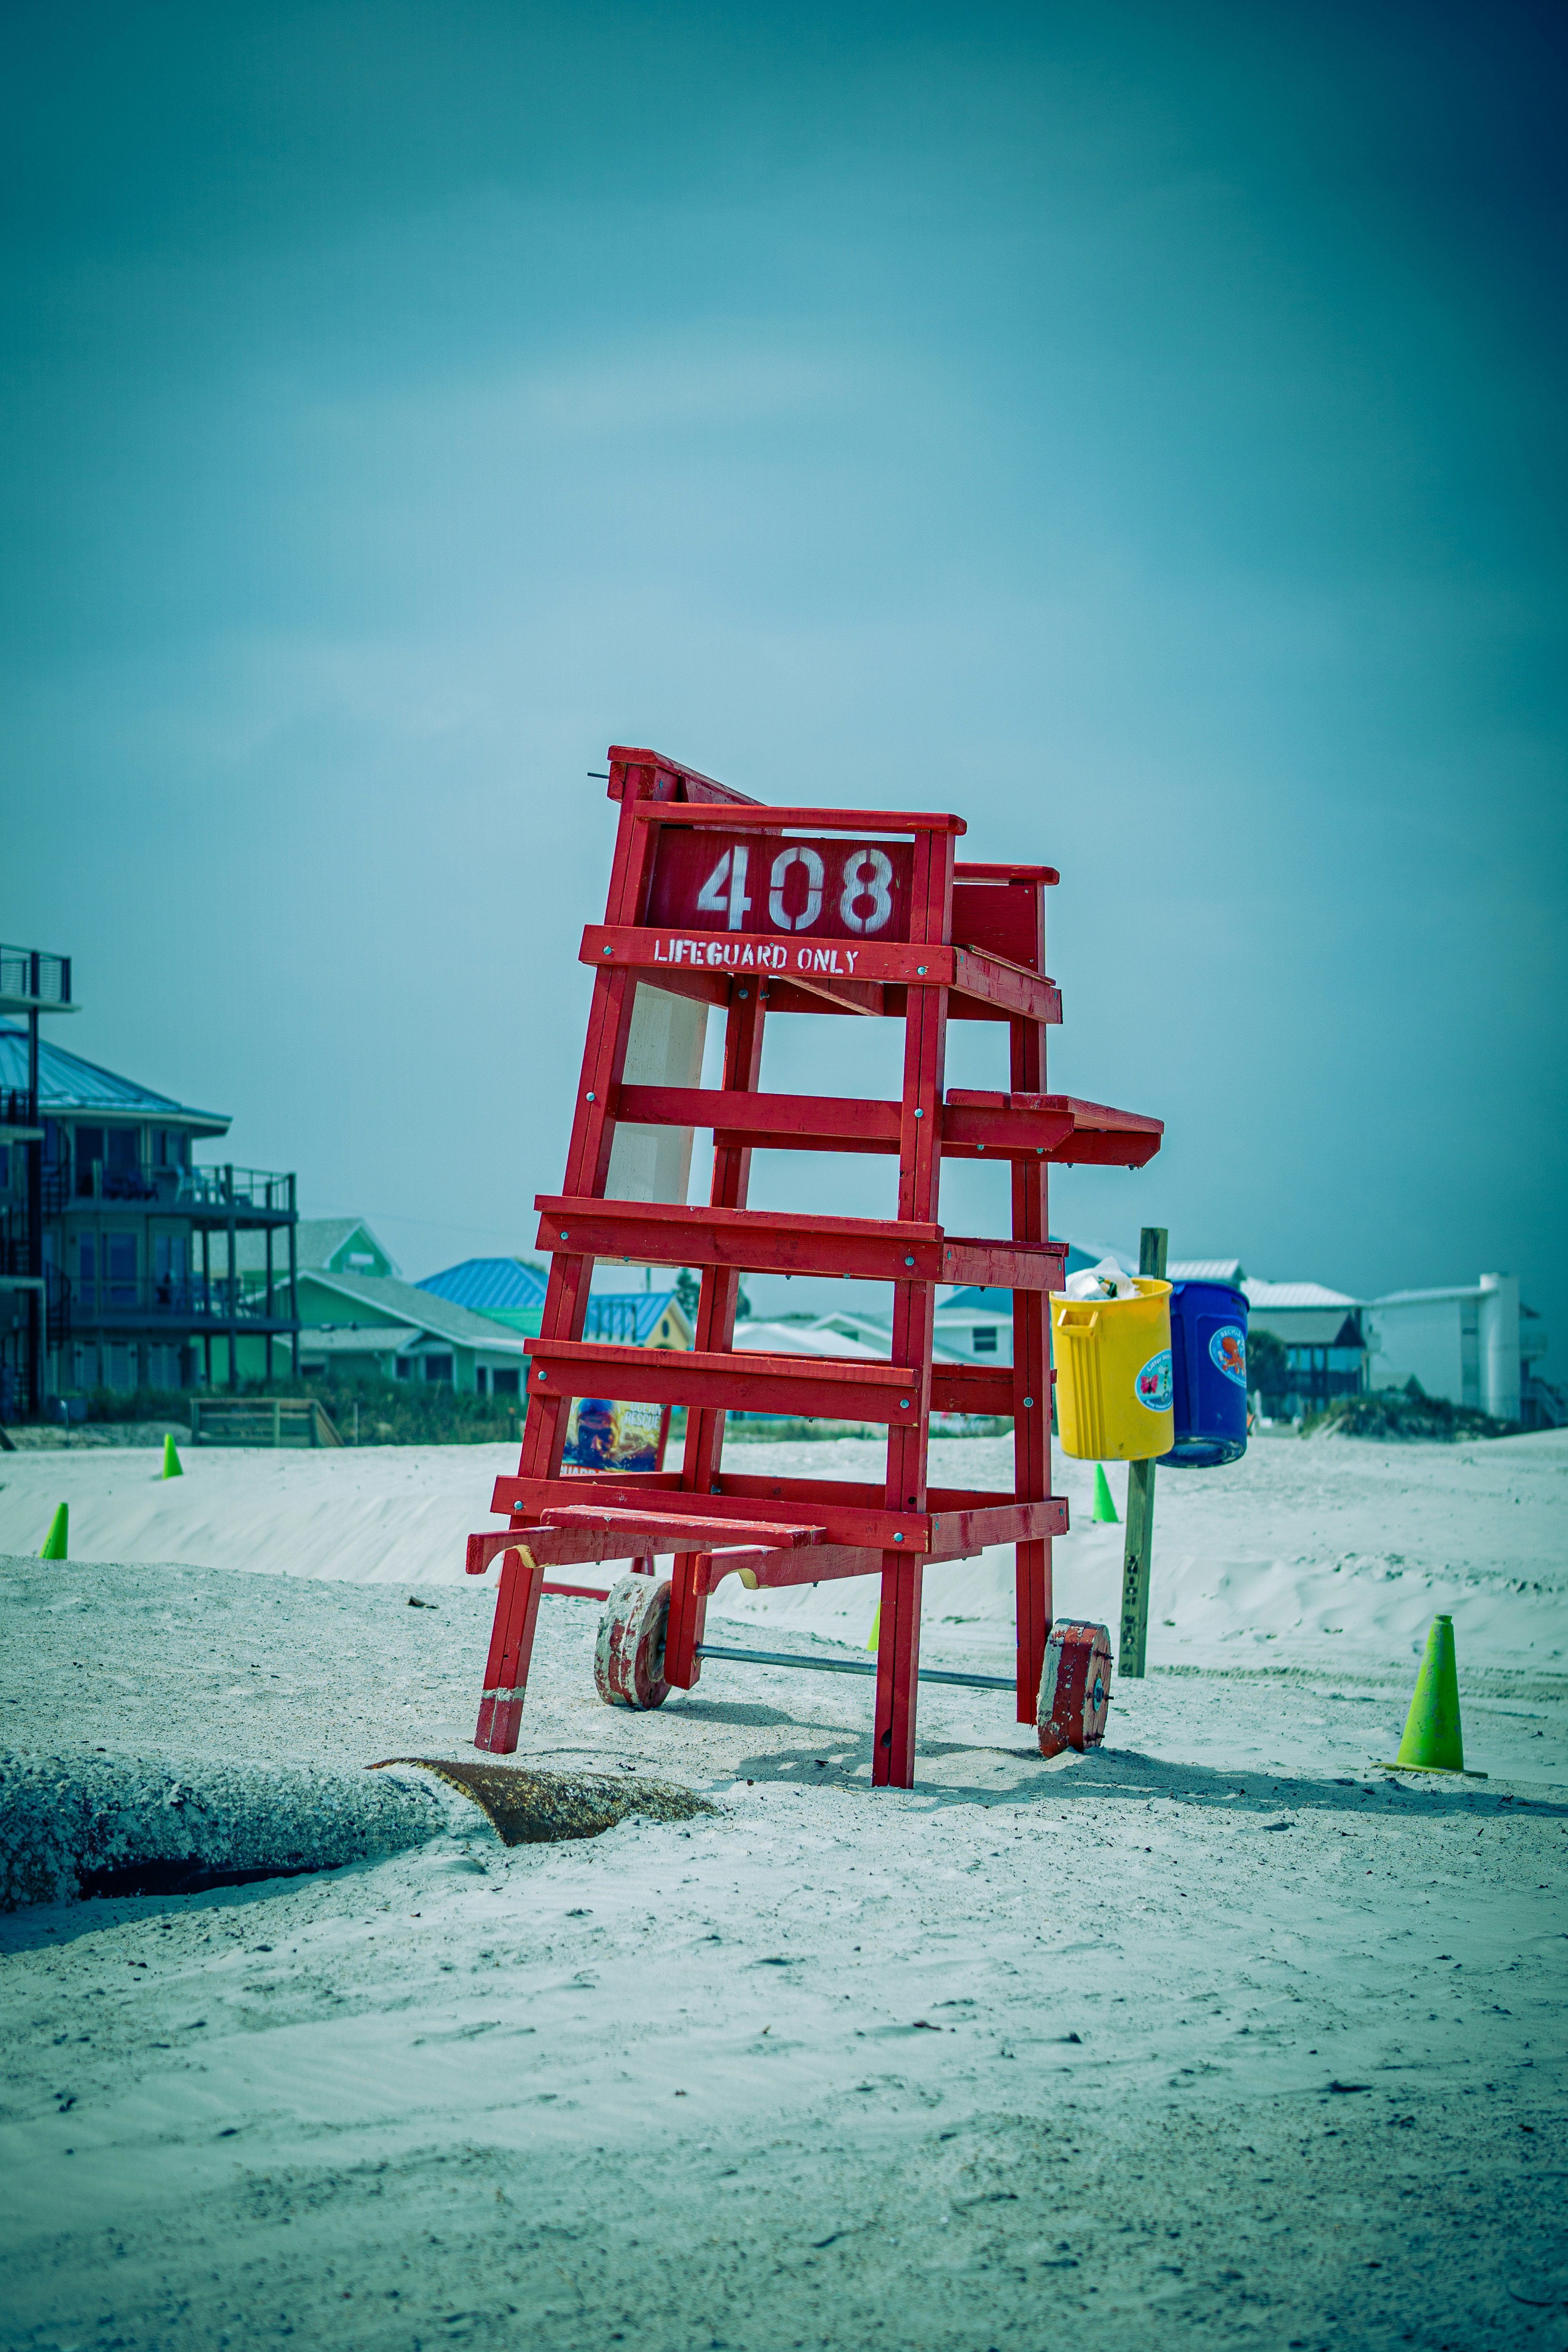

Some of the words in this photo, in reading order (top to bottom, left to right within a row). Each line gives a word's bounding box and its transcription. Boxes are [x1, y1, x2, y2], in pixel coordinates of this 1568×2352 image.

[697, 845, 893, 933] 408
[654, 938, 788, 969] LIFEGUARD
[797, 948, 860, 974] ONLY
[624, 1411, 661, 1429] RESCUE
